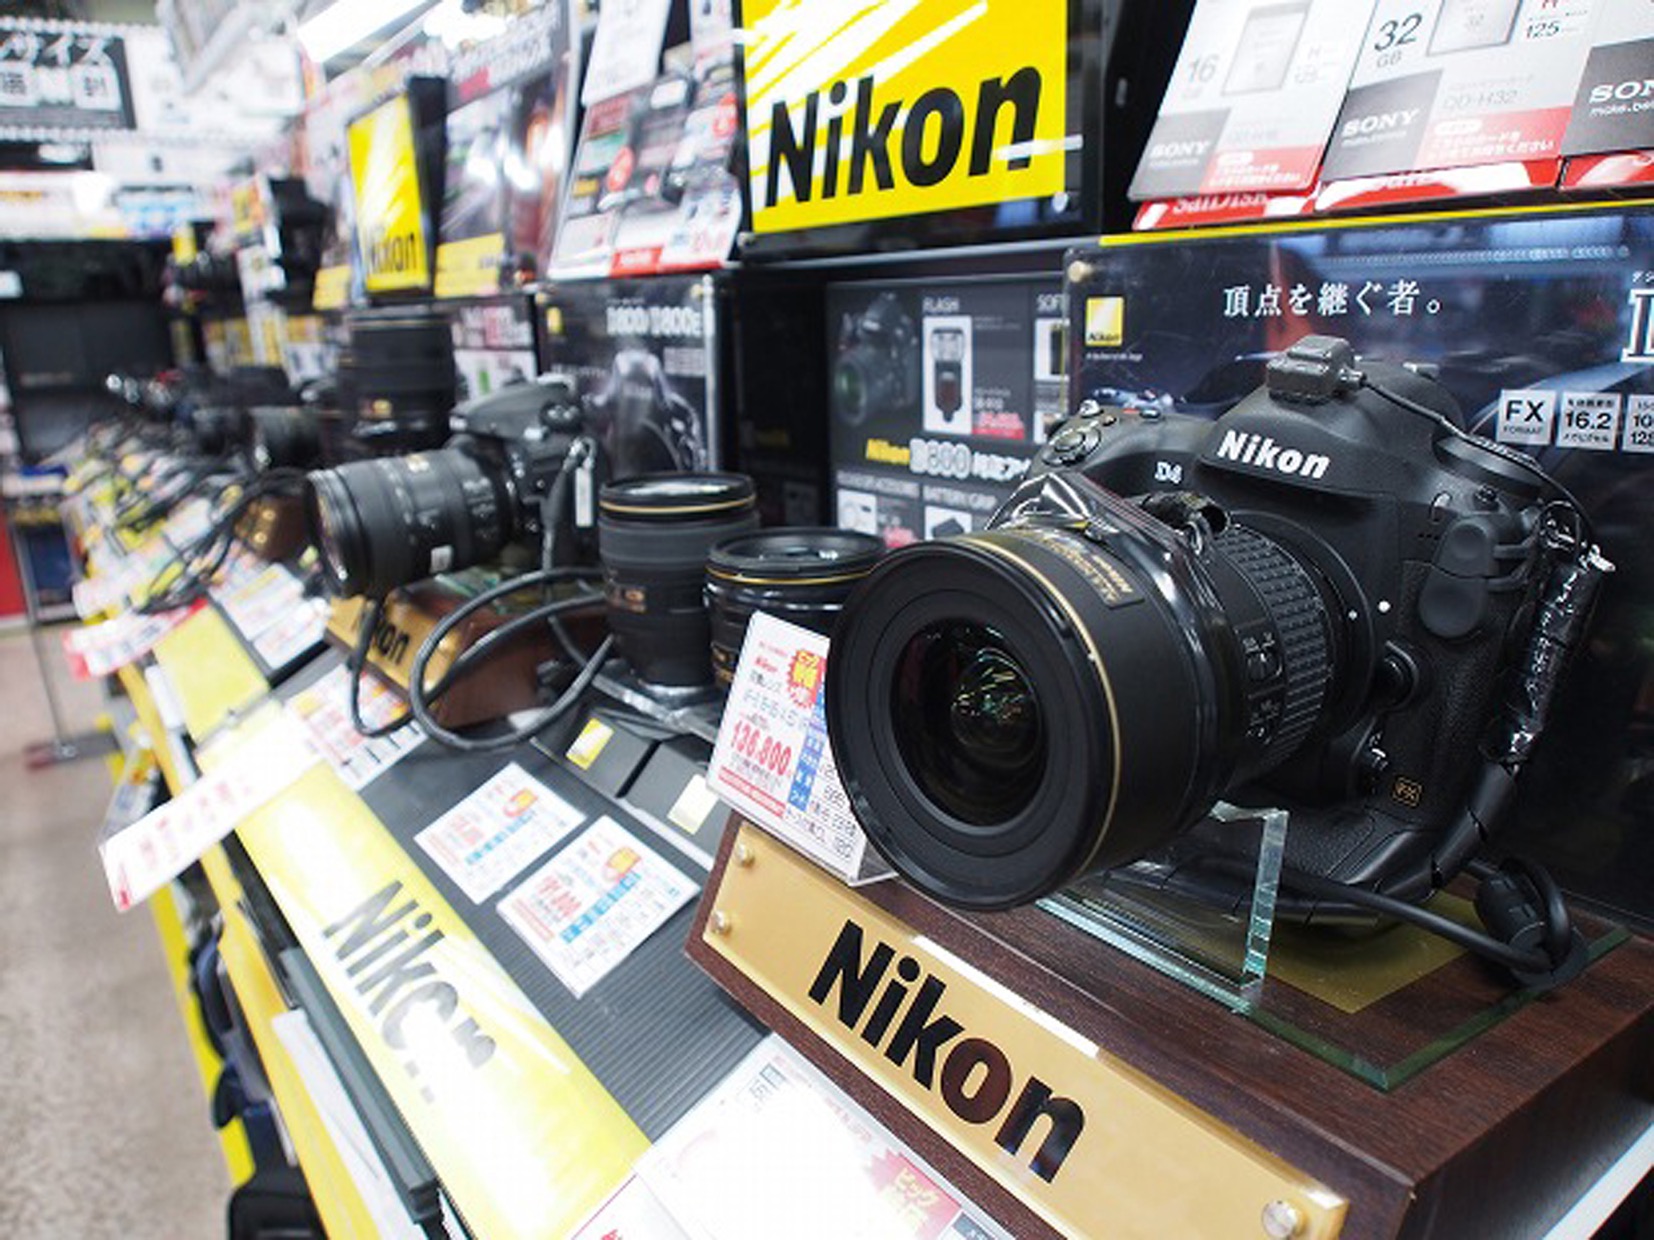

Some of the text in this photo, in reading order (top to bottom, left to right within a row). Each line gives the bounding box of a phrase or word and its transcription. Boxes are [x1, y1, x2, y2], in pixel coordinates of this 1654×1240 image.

[1374, 13, 1424, 52] 32
[1526, 20, 1560, 40] 125
[1340, 108, 1420, 138] SONY
[764, 66, 1042, 208] Nikon
[1149, 140, 1212, 159] SONY
[922, 296, 960, 313] FLASH
[1222, 280, 1443, 317] 頂点を継ぐ者。
[1087, 331, 1120, 342] Nikon
[1505, 400, 1545, 423] FX
[1565, 411, 1613, 430] 16.2
[1217, 429, 1330, 479] Nikon
[1154, 461, 1183, 485] D4
[807, 918, 1086, 1185] Nikon
